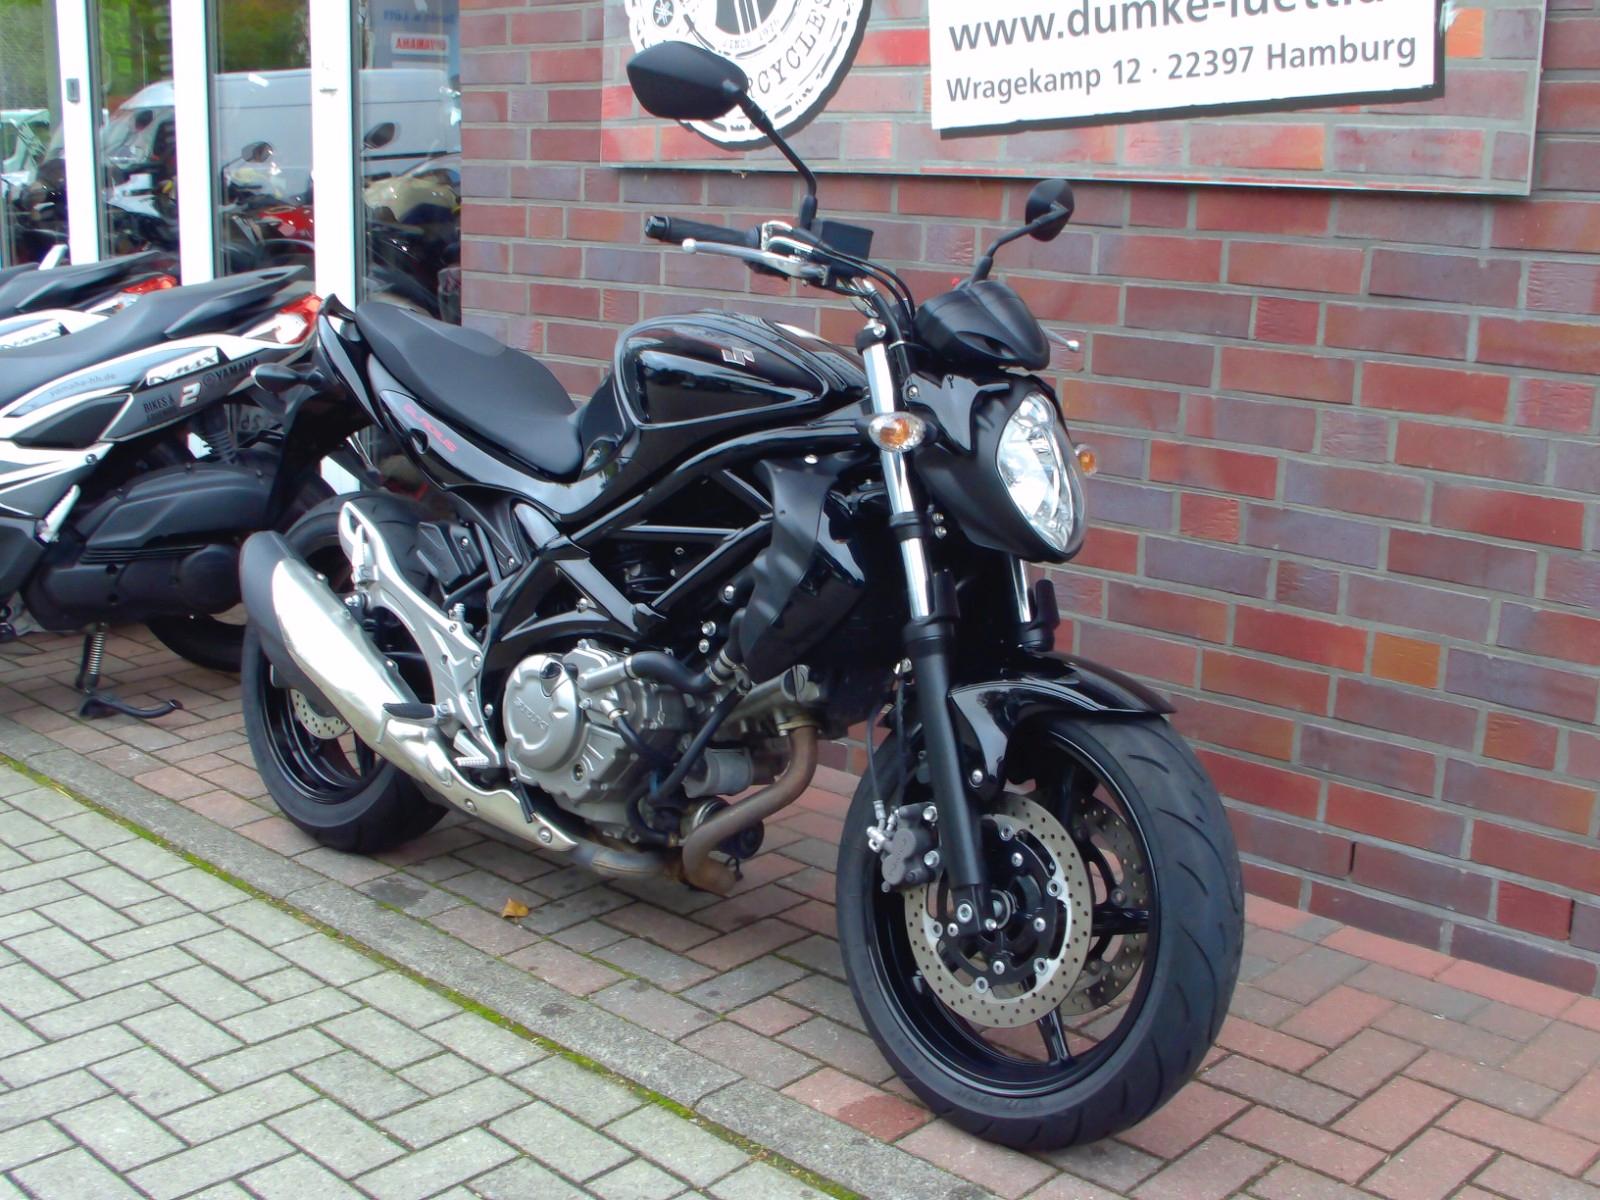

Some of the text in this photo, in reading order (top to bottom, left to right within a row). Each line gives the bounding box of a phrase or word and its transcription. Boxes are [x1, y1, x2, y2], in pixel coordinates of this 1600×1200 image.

[947, 67, 1101, 104] Wragekamp
[1113, 58, 1142, 85] 12
[1168, 46, 1254, 80] 22397
[1267, 35, 1416, 68] Hamburg
